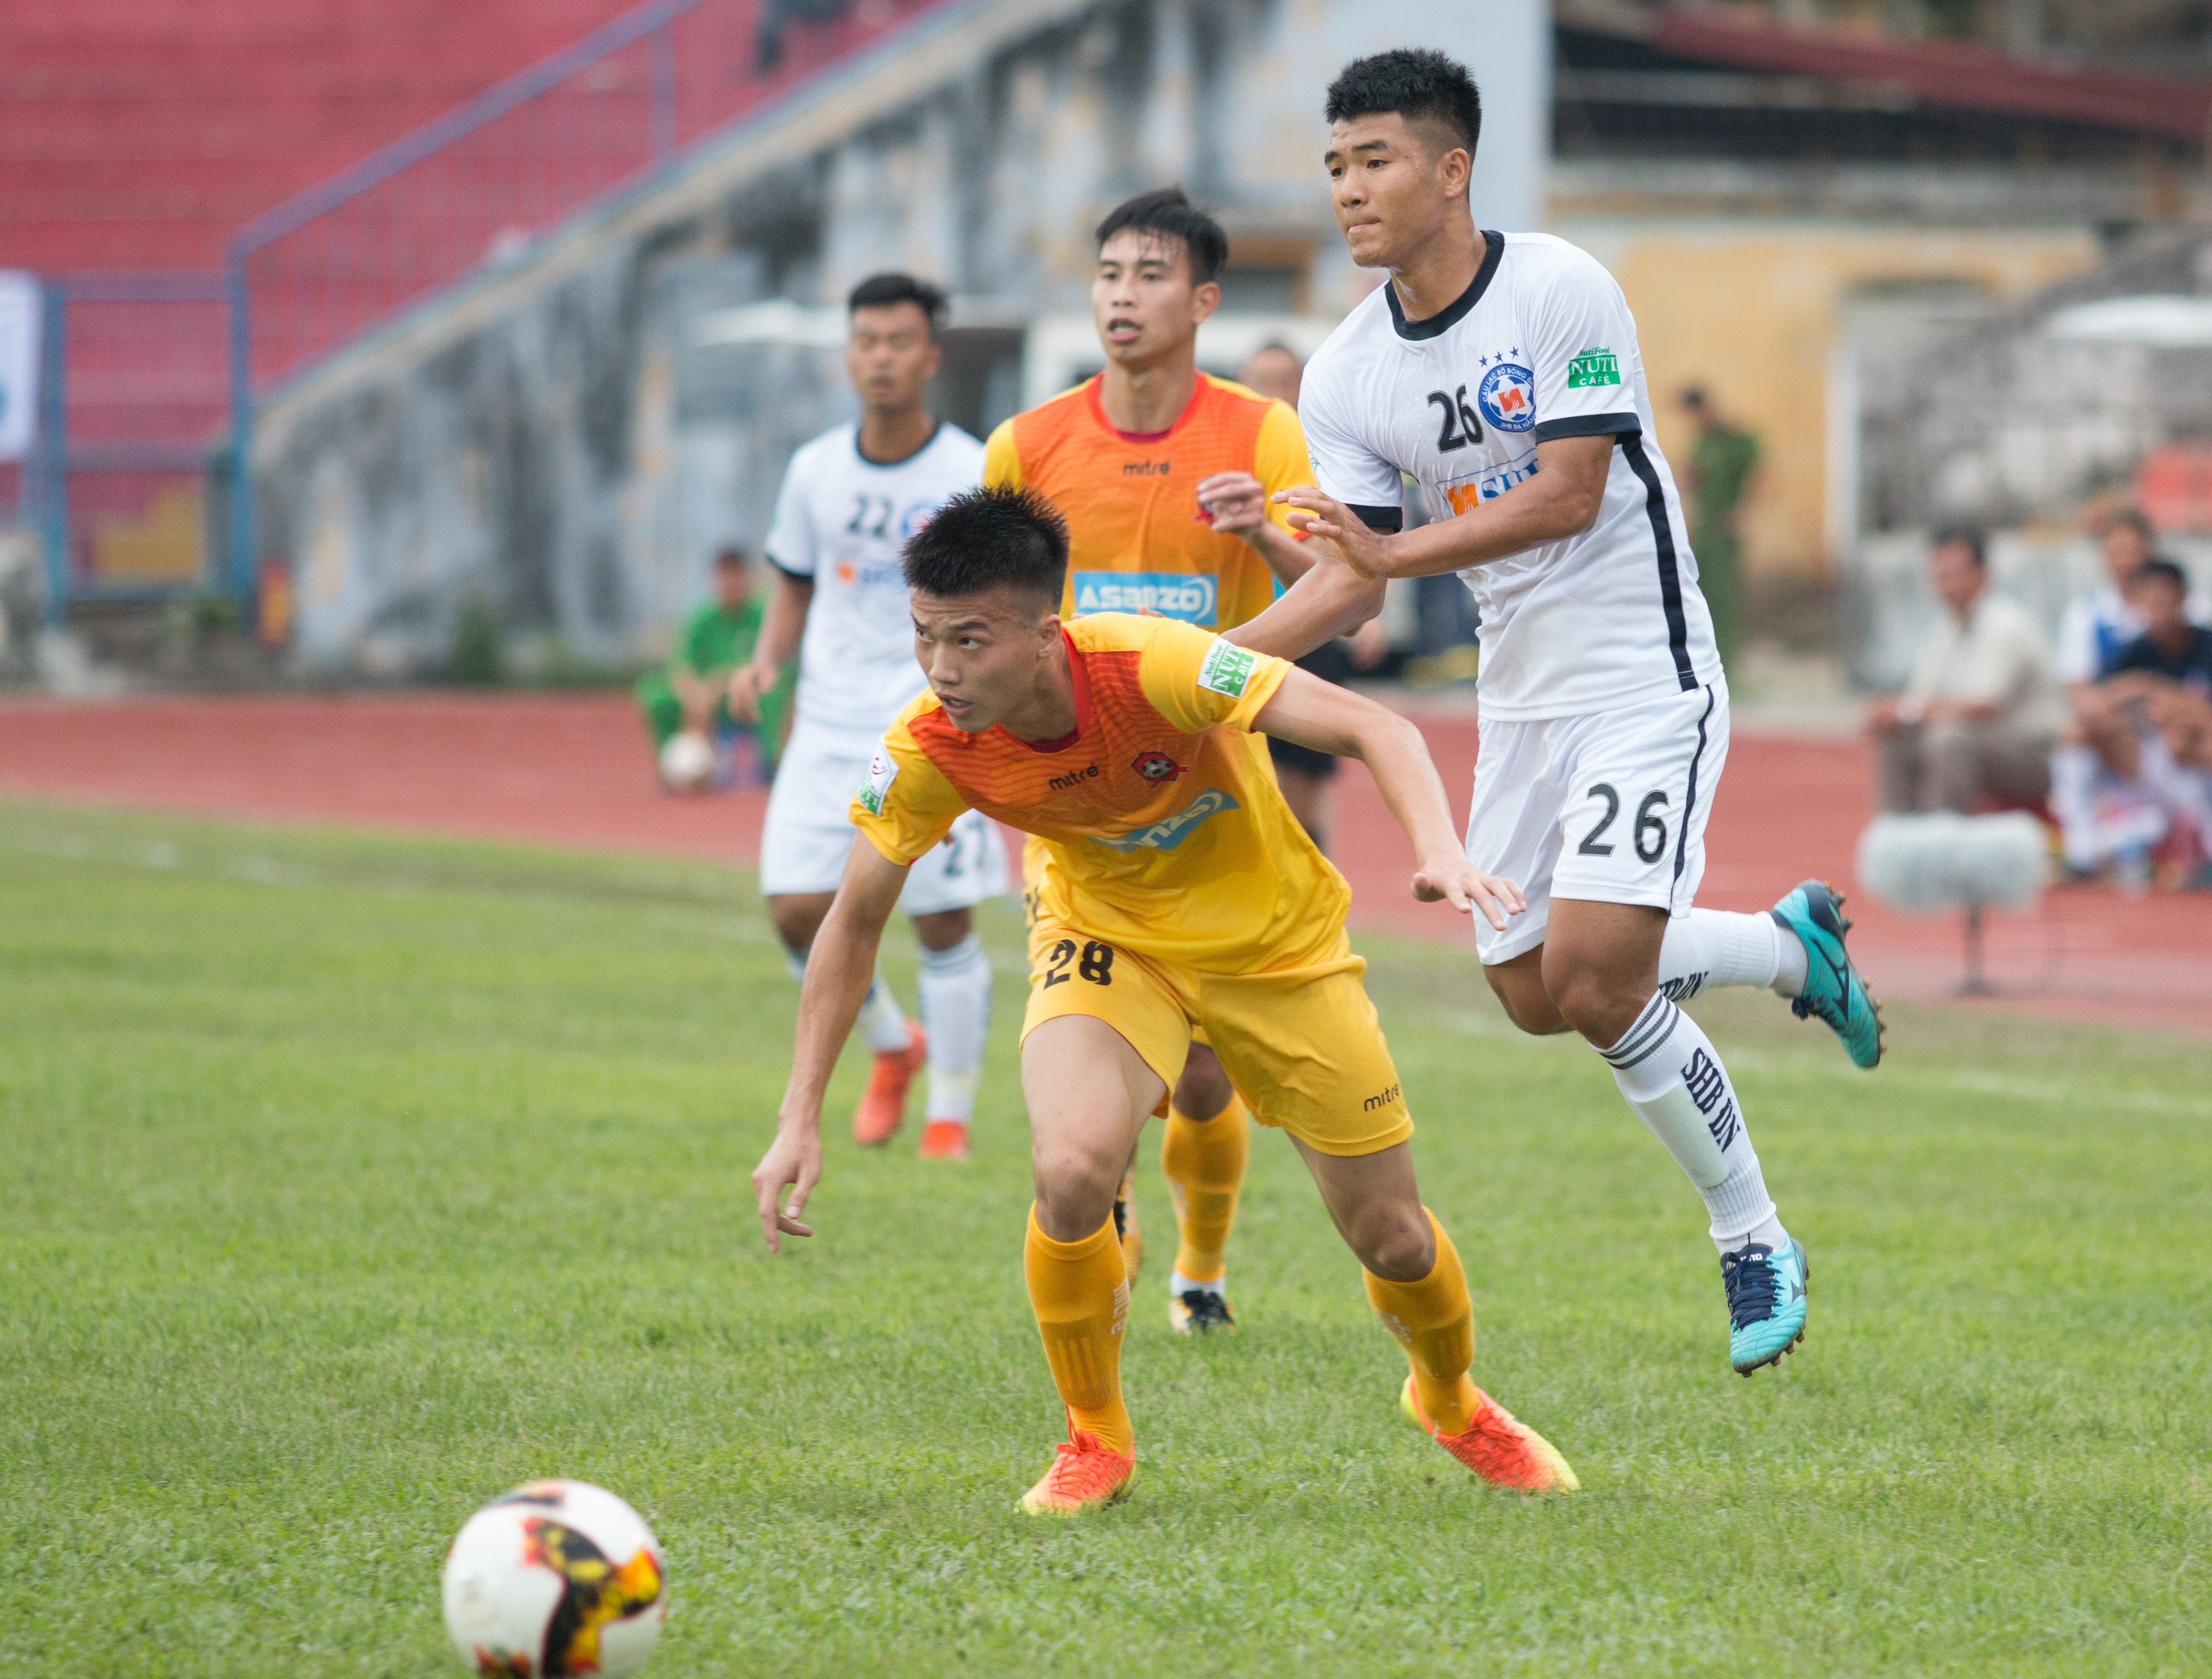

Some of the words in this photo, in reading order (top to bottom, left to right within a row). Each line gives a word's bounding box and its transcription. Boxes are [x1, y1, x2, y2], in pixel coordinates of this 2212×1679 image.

[1569, 357, 1617, 375] NUTI
[1579, 374, 1611, 386] CAFÉ
[1427, 383, 1484, 454] 26
[847, 494, 893, 538] 22
[1576, 782, 1671, 865] 26
[1043, 939, 1114, 990] 28
[1681, 1047, 1724, 1115] SHB
[1708, 1097, 1740, 1153] DN
